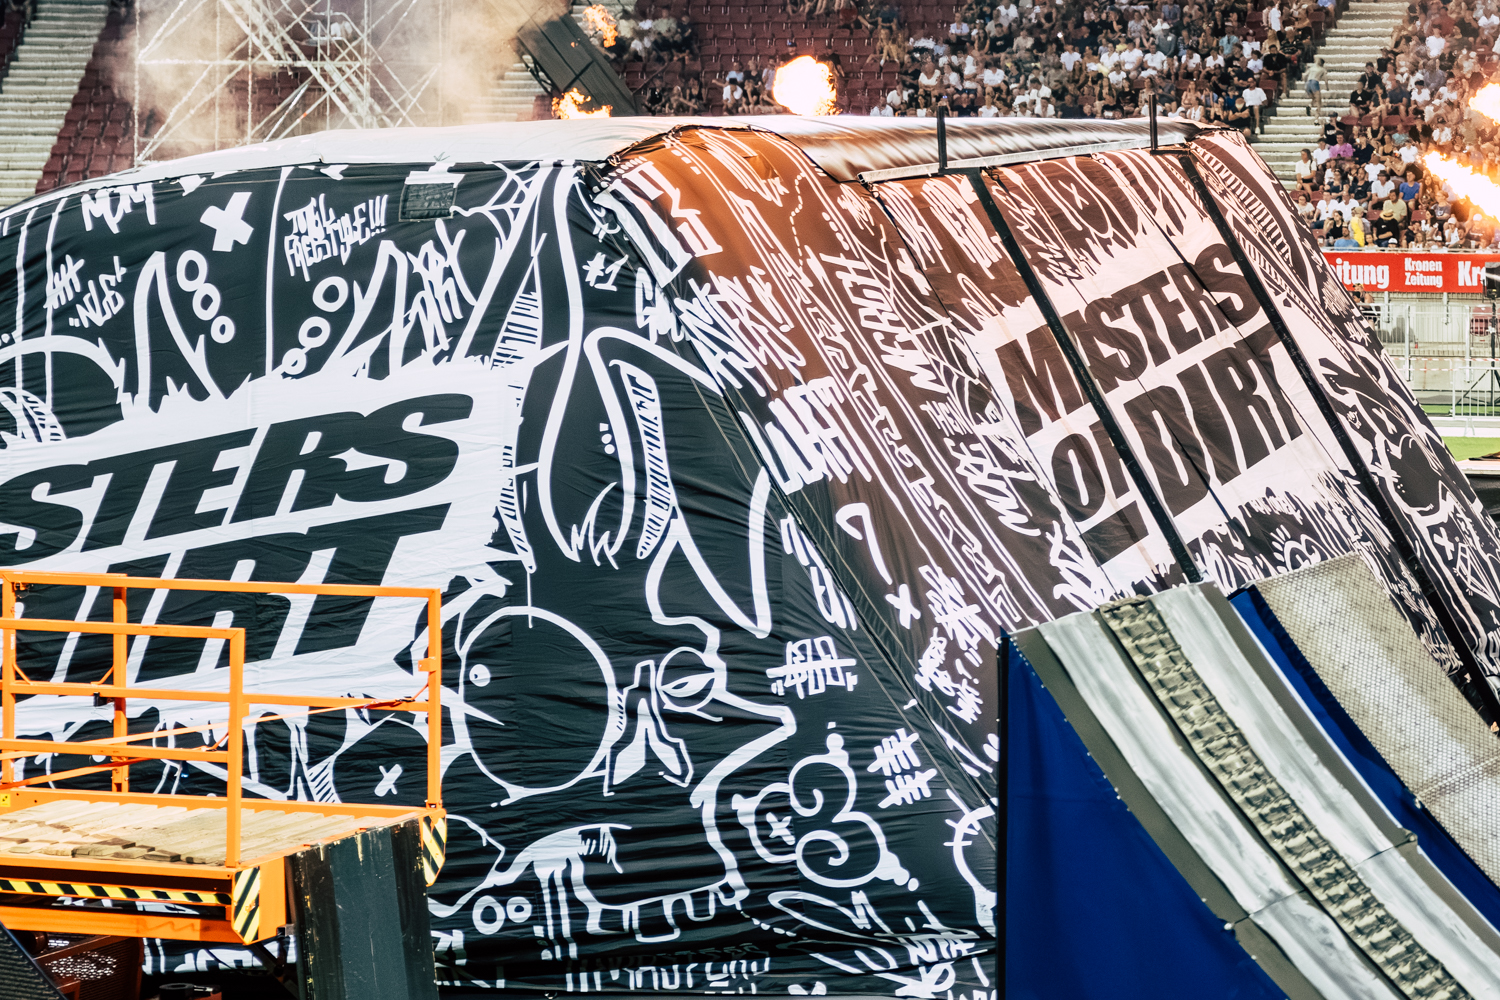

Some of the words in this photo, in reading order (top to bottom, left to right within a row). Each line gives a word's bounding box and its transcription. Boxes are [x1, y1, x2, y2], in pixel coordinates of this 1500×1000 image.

[1404, 257, 1443, 272] Kronen
[1404, 272, 1443, 288] Zeitung
[996, 243, 1263, 437] MASTERS
[1124, 322, 1303, 518] DIRT
